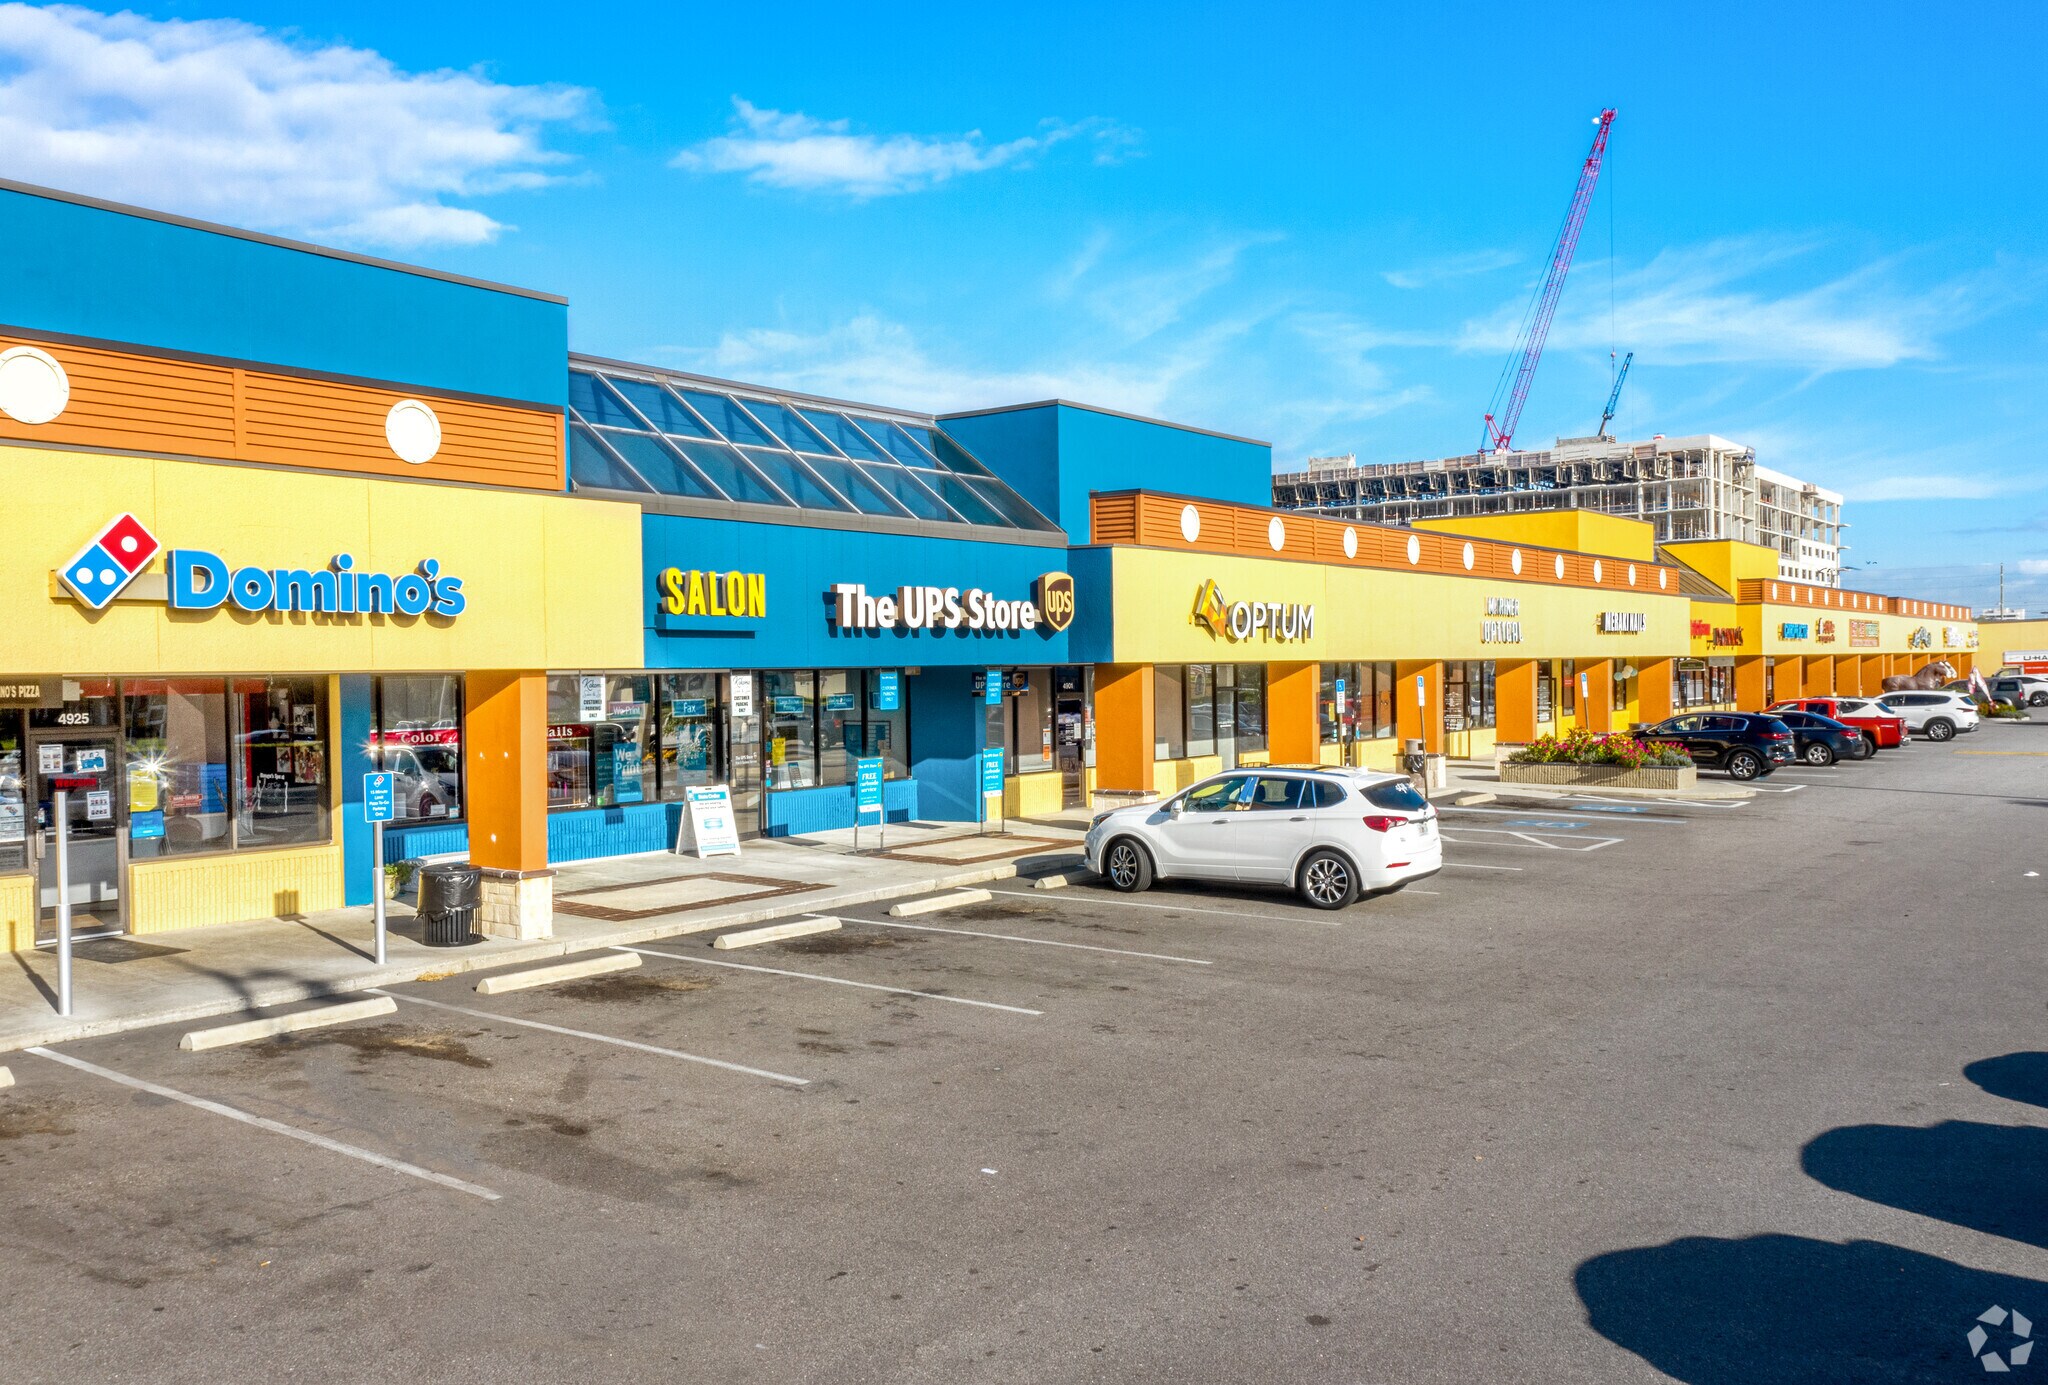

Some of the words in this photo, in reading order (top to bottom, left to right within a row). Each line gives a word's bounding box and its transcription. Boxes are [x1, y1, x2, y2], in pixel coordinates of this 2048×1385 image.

[168, 549, 467, 617] Domino's
[663, 567, 766, 618] SALON
[836, 584, 896, 628] The
[902, 586, 961, 629] UPS
[967, 588, 1035, 630] Store
[1047, 590, 1072, 622] ups
[1230, 601, 1315, 640] OPTUM
[1604, 612, 1629, 631] MERAKI
[1630, 613, 1647, 632] NAILS
[18, 685, 40, 698] PIZZA
[613, 706, 621, 715] We
[622, 705, 641, 715] Print
[683, 702, 696, 713] Fax
[58, 713, 89, 725] 4925
[400, 732, 442, 744] Color
[547, 726, 573, 738] ails
[615, 748, 632, 761] We
[615, 761, 641, 775] Print
[862, 772, 877, 780] FREE
